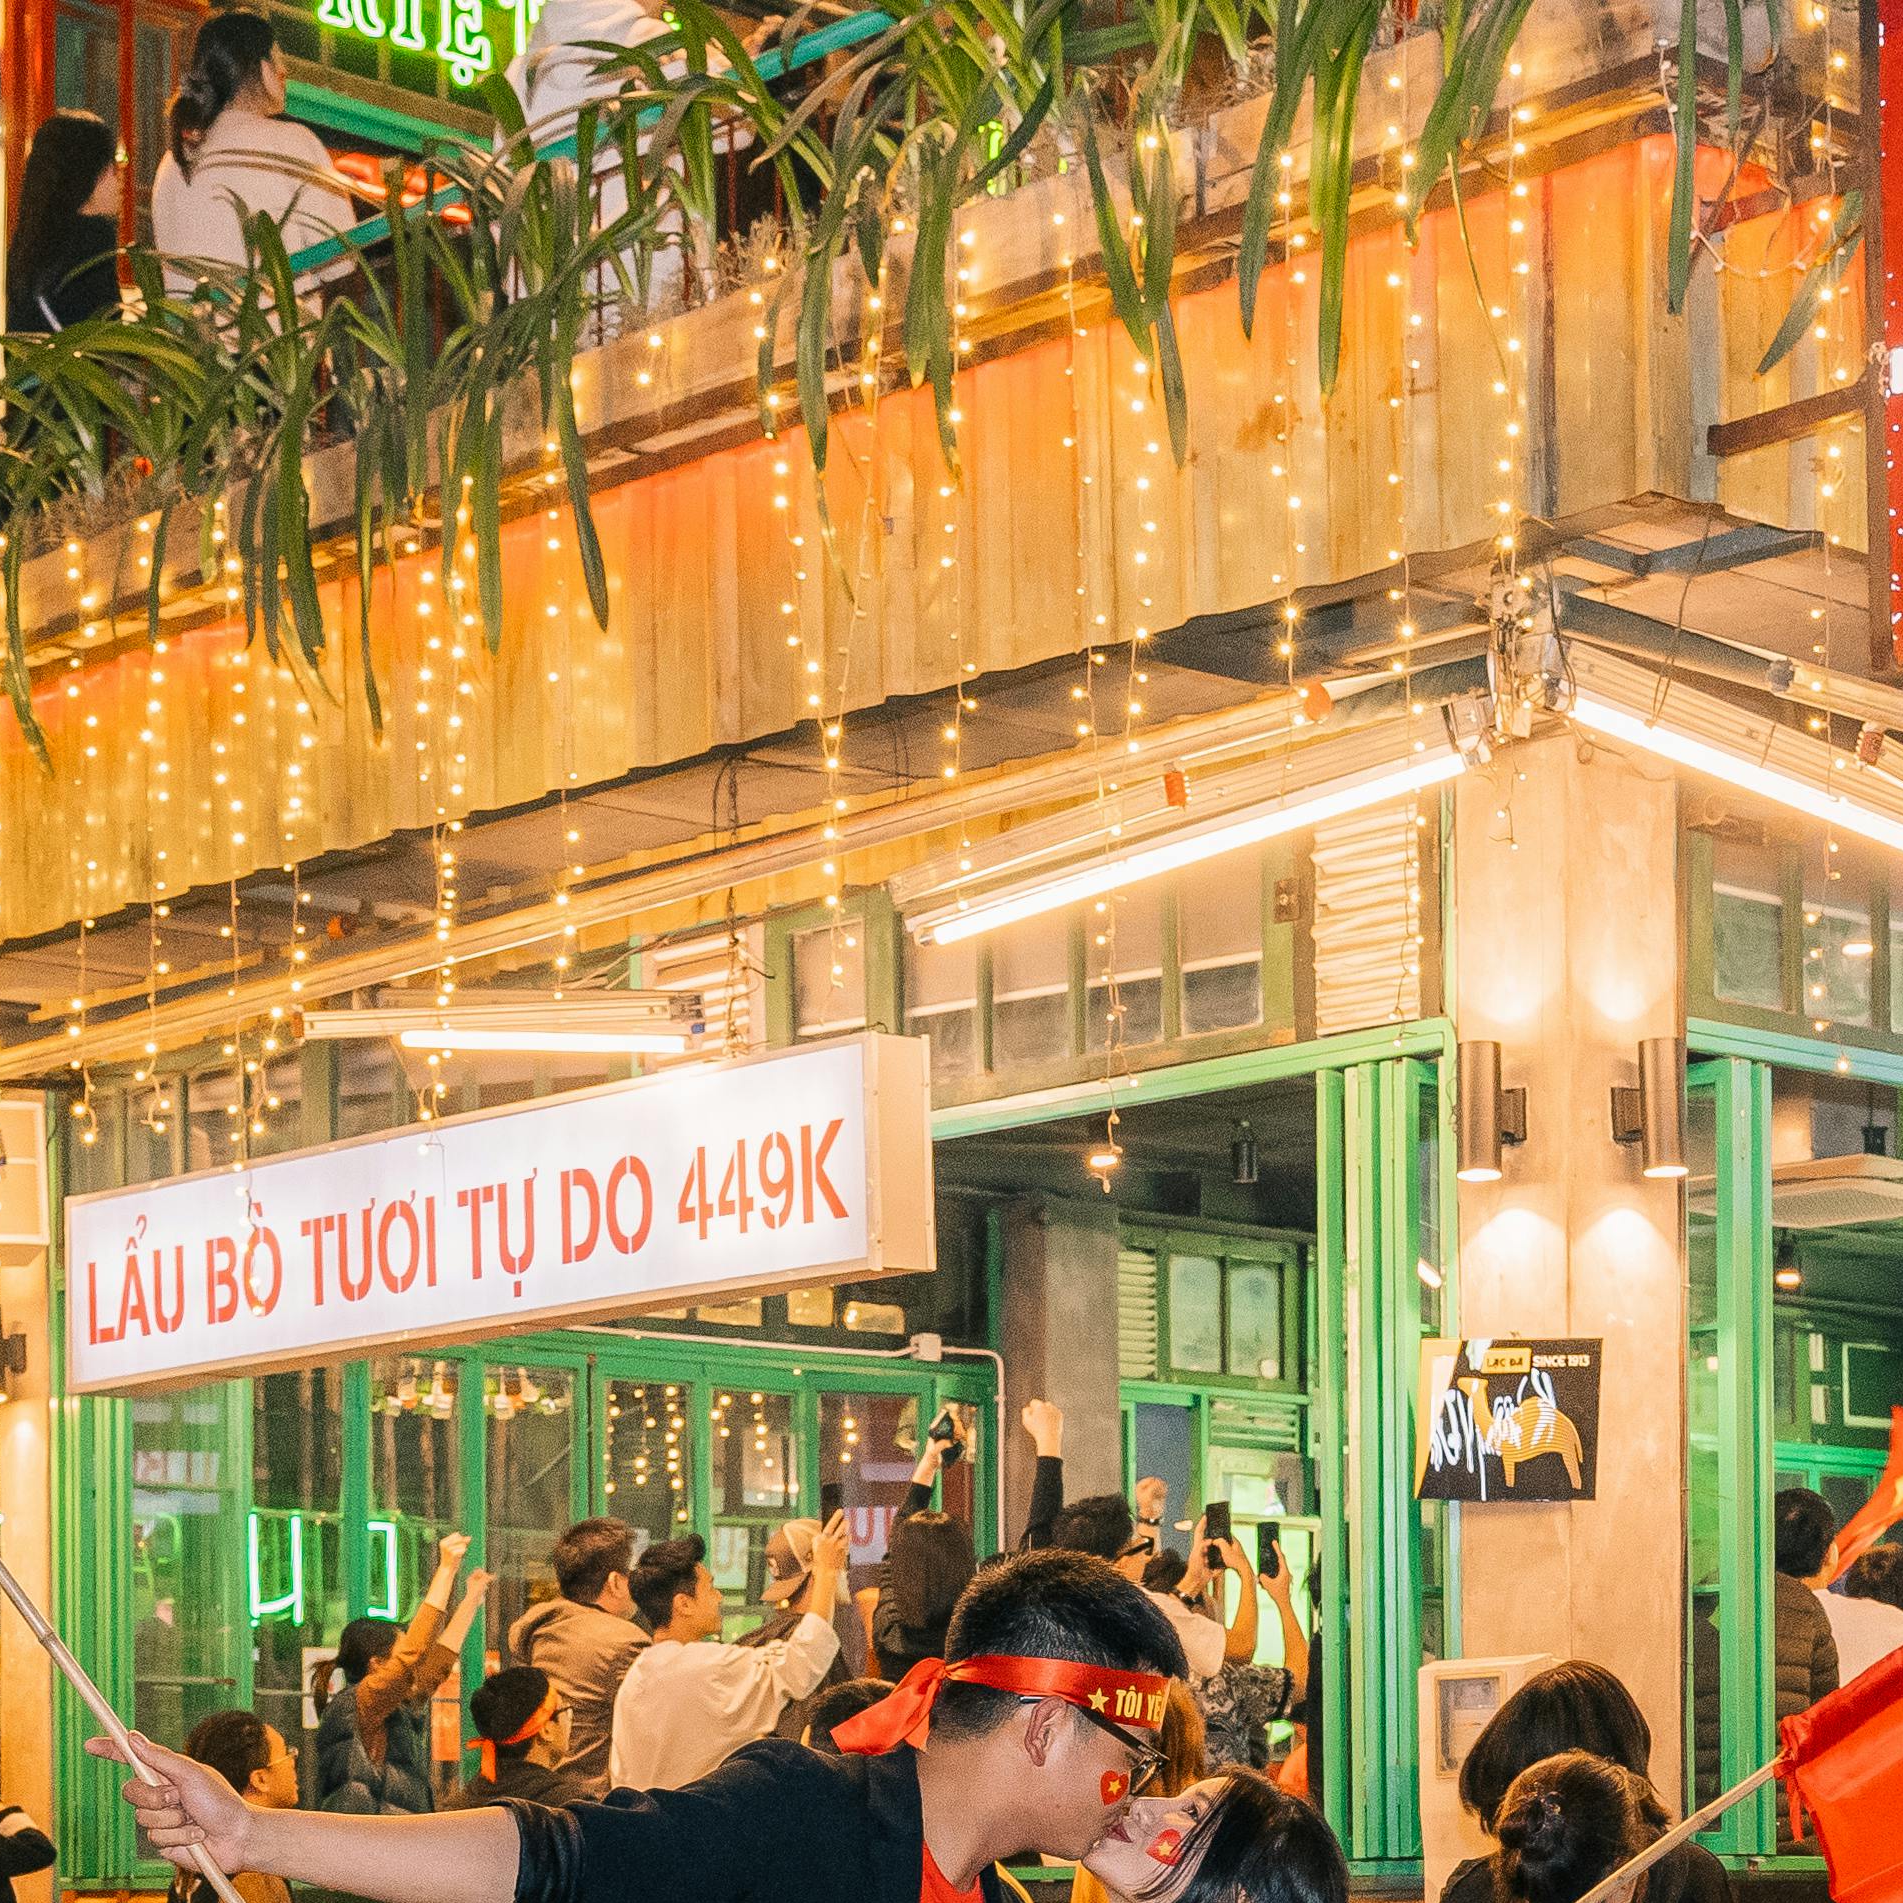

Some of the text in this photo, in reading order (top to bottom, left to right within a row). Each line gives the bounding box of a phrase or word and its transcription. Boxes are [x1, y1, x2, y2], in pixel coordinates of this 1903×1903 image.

[87, 1118, 849, 1346] LẨU BÒ TƯƠI TỰ DO 449K
[1116, 1685, 1164, 1722] TÔI YÊ
